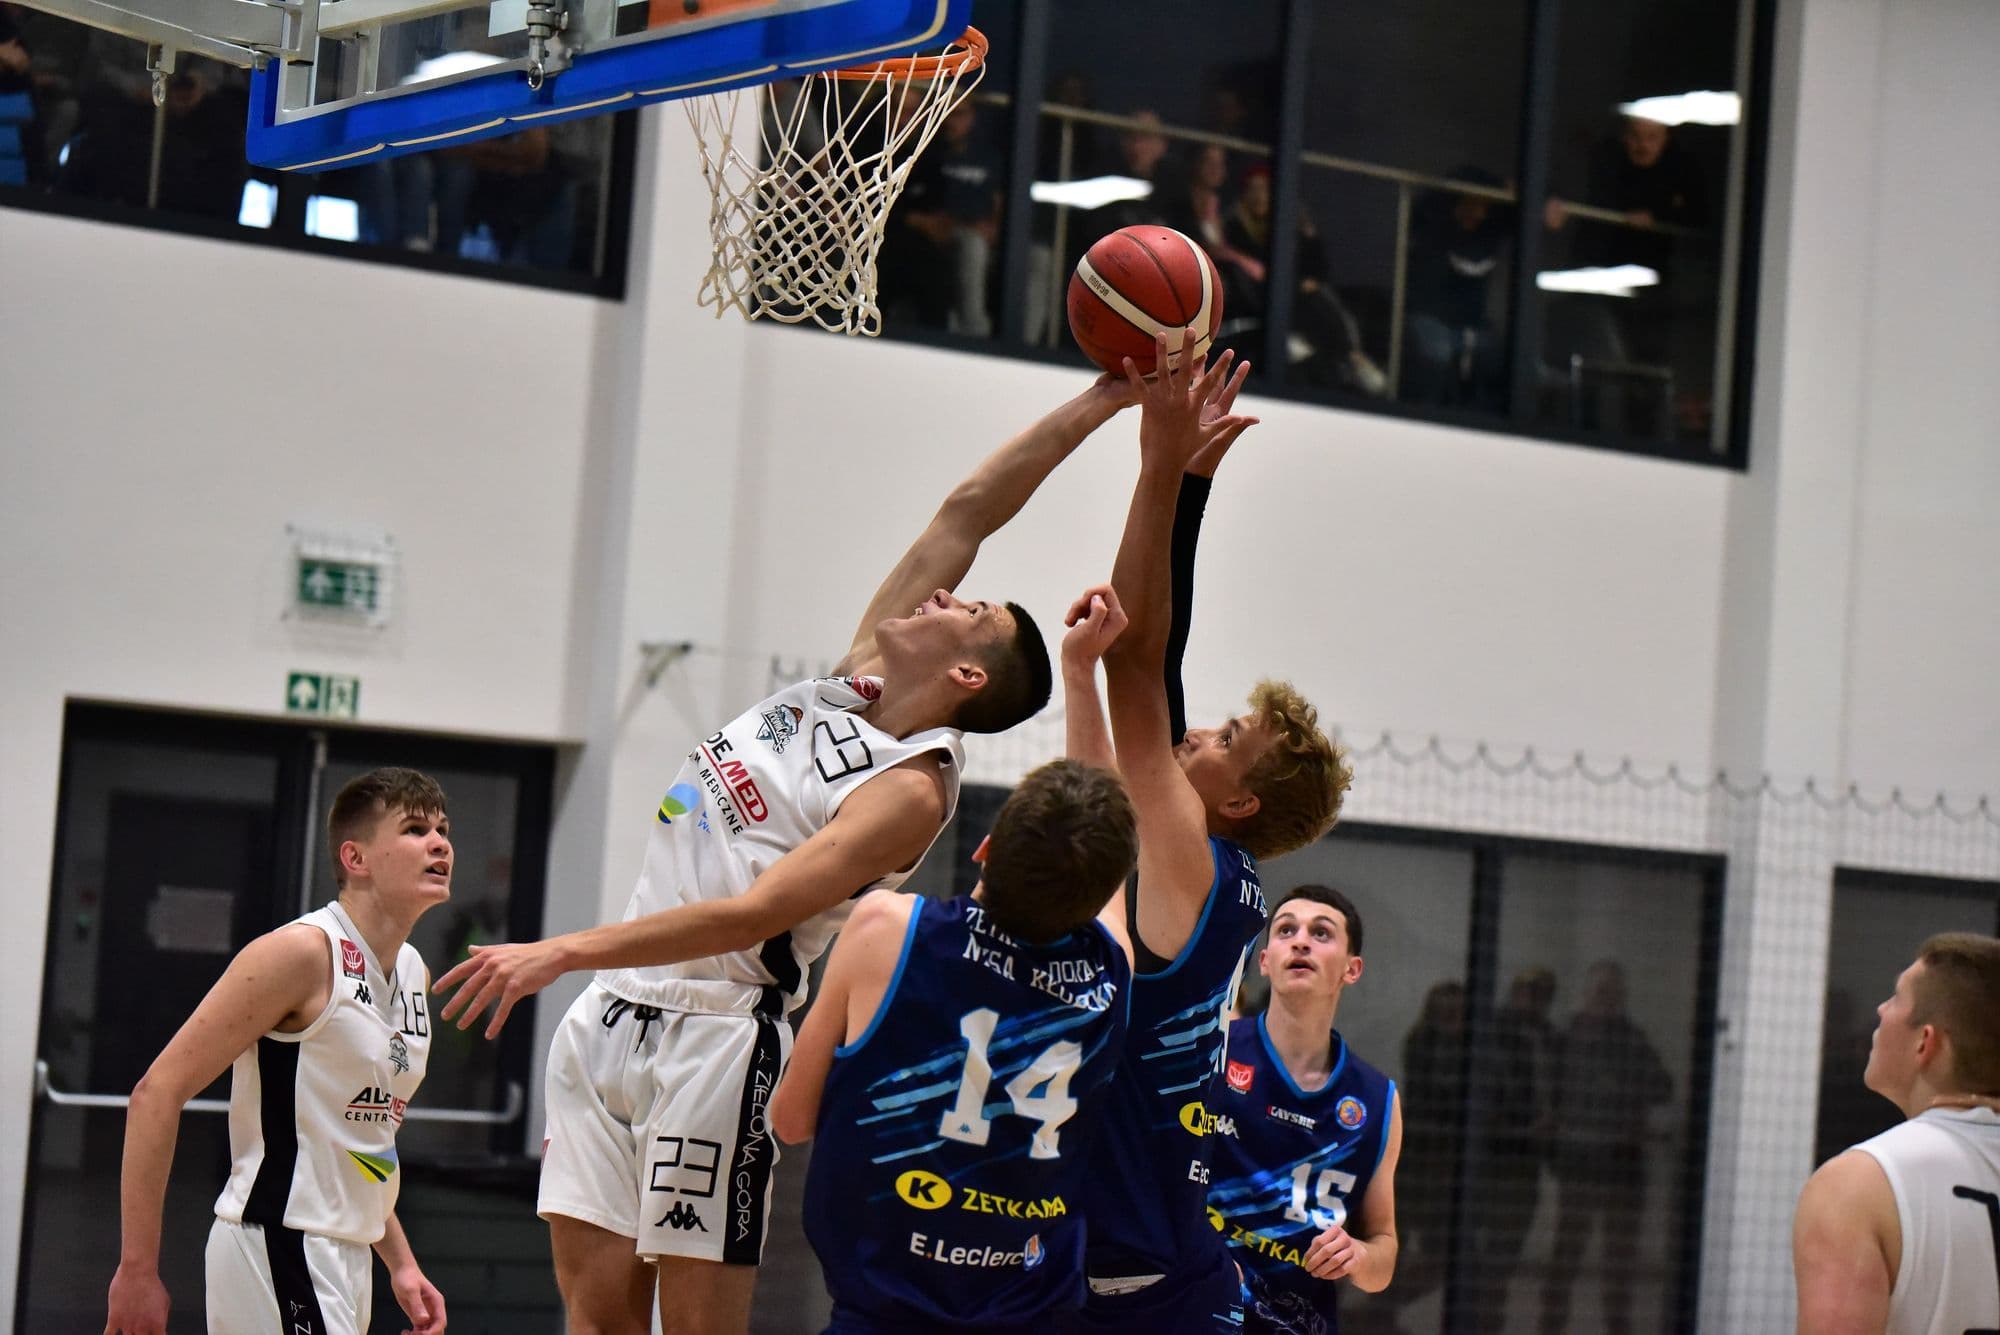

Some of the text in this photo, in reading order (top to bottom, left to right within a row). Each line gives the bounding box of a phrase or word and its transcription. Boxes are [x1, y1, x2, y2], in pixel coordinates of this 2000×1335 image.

[699, 768, 743, 836] MEDYCZNE
[400, 990, 428, 1038] 18
[938, 1007, 1083, 1160] 14
[738, 1069, 773, 1168] ZIELONA
[650, 1136, 722, 1198] 23
[1284, 1162, 1357, 1230] 15
[1232, 1223, 1307, 1268] ZETKA
